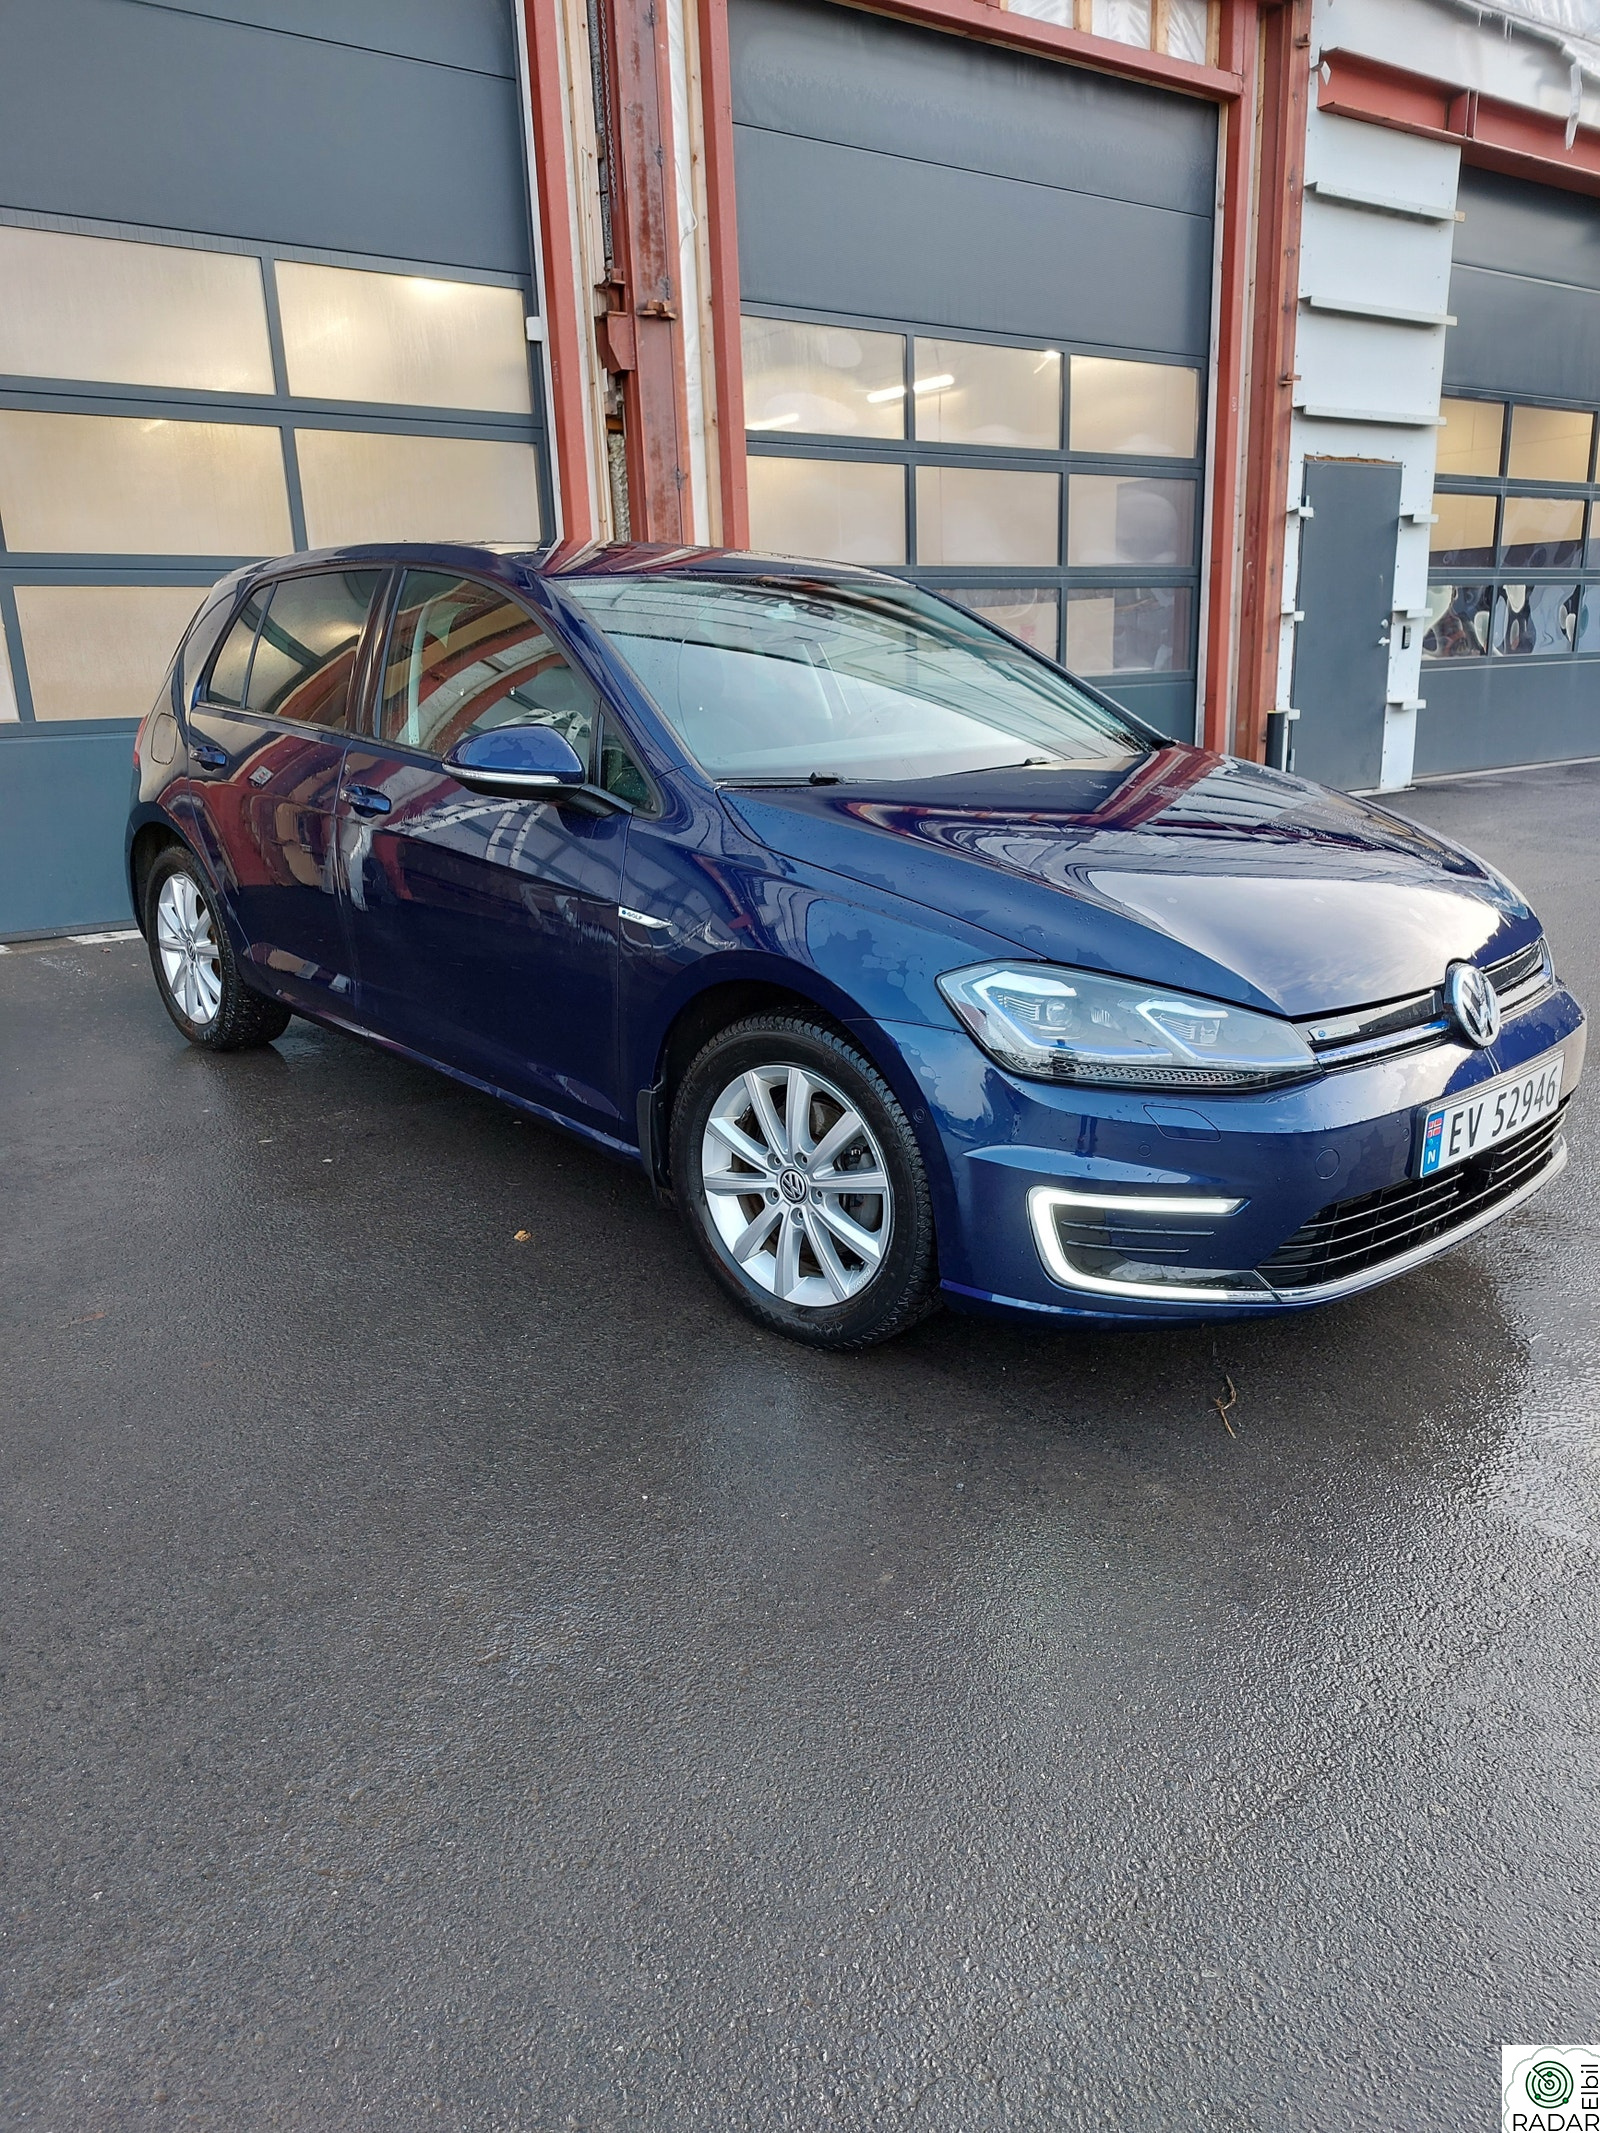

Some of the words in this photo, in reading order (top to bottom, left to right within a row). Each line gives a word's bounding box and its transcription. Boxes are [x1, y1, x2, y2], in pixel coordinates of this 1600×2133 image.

[1448, 1103, 1484, 1156] EV
[1491, 1065, 1558, 1137] 52946
[1426, 1149, 1437, 1165] N
